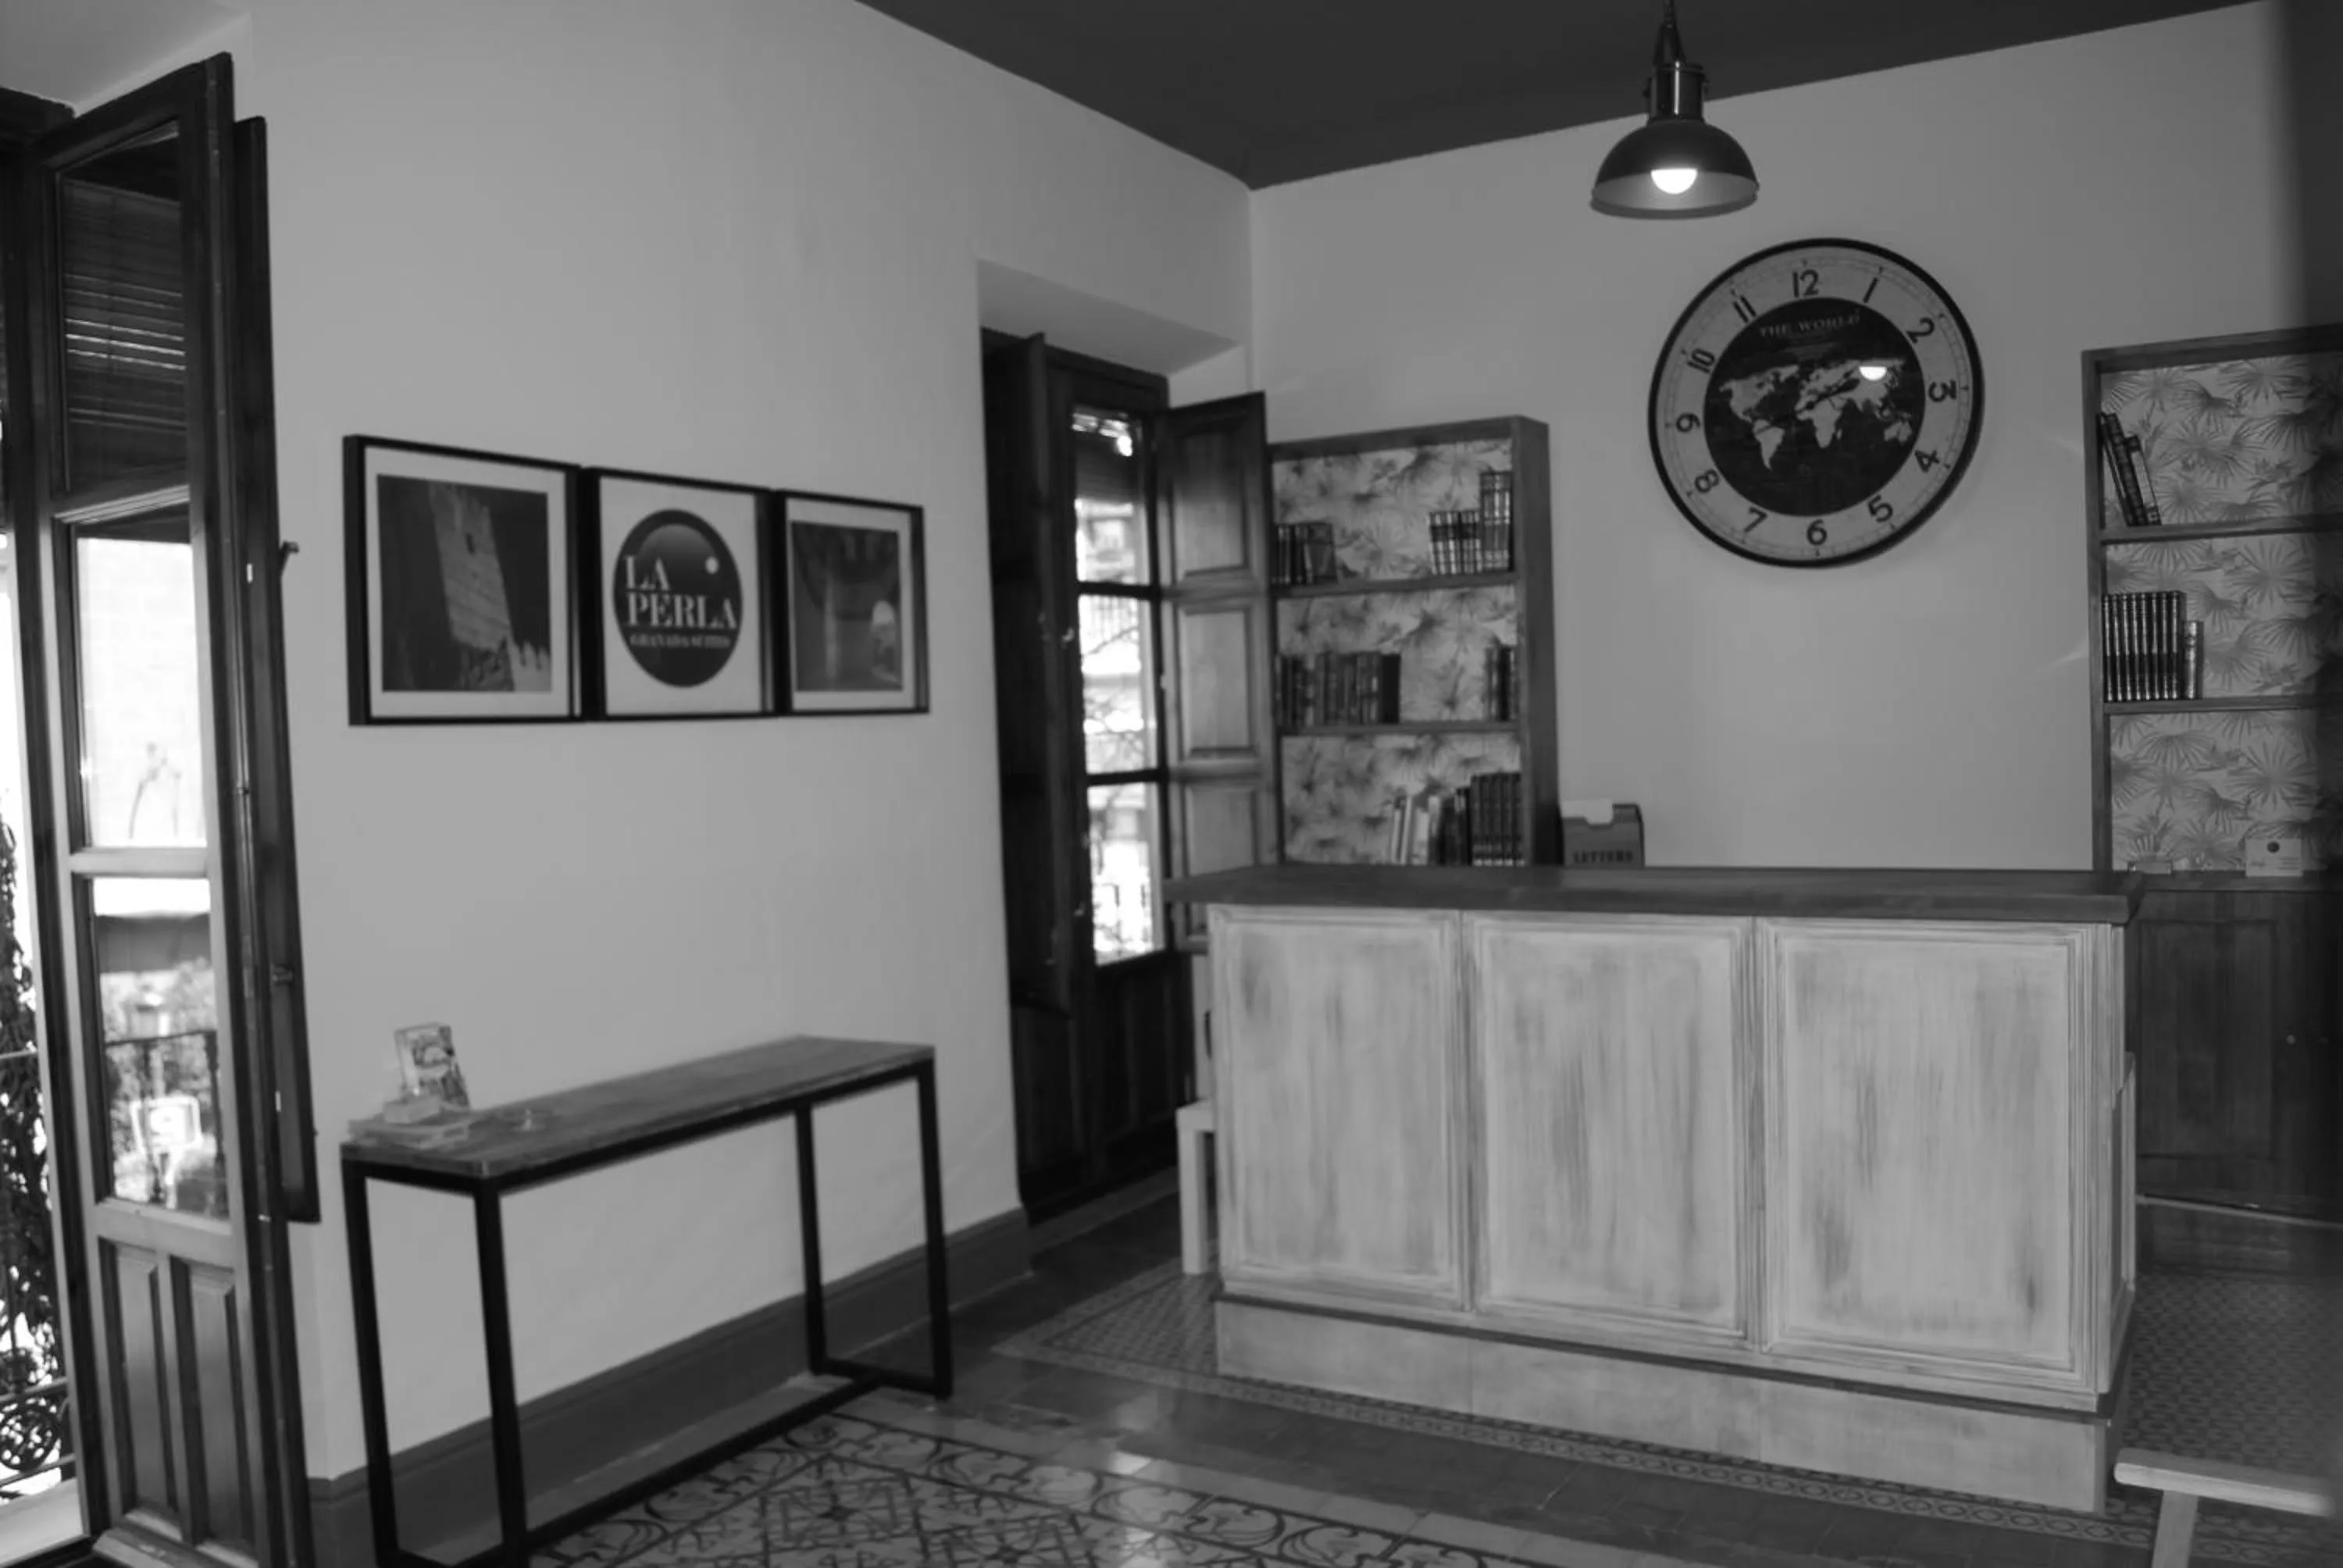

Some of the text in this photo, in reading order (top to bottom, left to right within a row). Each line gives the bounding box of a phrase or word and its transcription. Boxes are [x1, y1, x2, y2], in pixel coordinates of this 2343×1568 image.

[1792, 269, 1820, 298] 12
[1862, 276, 1879, 304] 1
[1731, 294, 1757, 324] 11
[1905, 317, 1936, 344] 2
[1686, 347, 1717, 375] 10
[1928, 380, 1958, 403] 3
[1674, 412, 1701, 434] 9
[1913, 448, 1942, 474] 4
[1694, 469, 1721, 495] 8
[1743, 506, 1769, 535] 7
[1867, 494, 1895, 524] 5
[1805, 519, 1829, 547] 6
[625, 555, 669, 591] LA
[627, 592, 737, 629] PERLA
